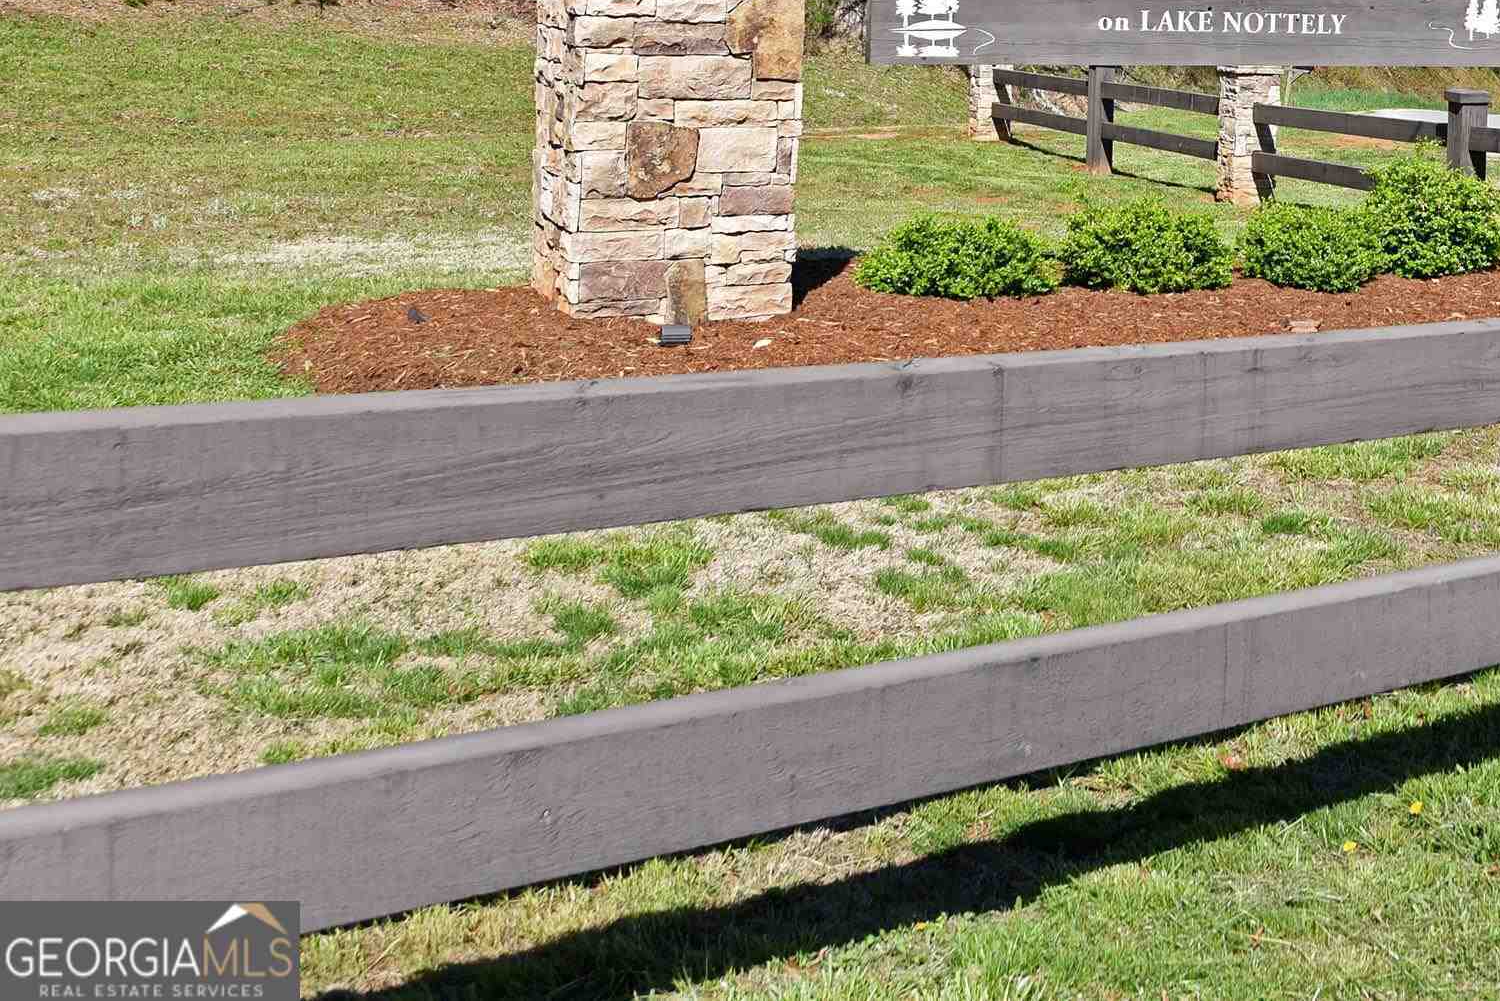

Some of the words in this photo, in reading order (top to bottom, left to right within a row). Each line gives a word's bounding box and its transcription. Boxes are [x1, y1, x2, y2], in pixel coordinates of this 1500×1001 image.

[1098, 16, 1131, 32] on
[1139, 9, 1214, 33] LAKE
[1222, 11, 1347, 35] NOTTELY
